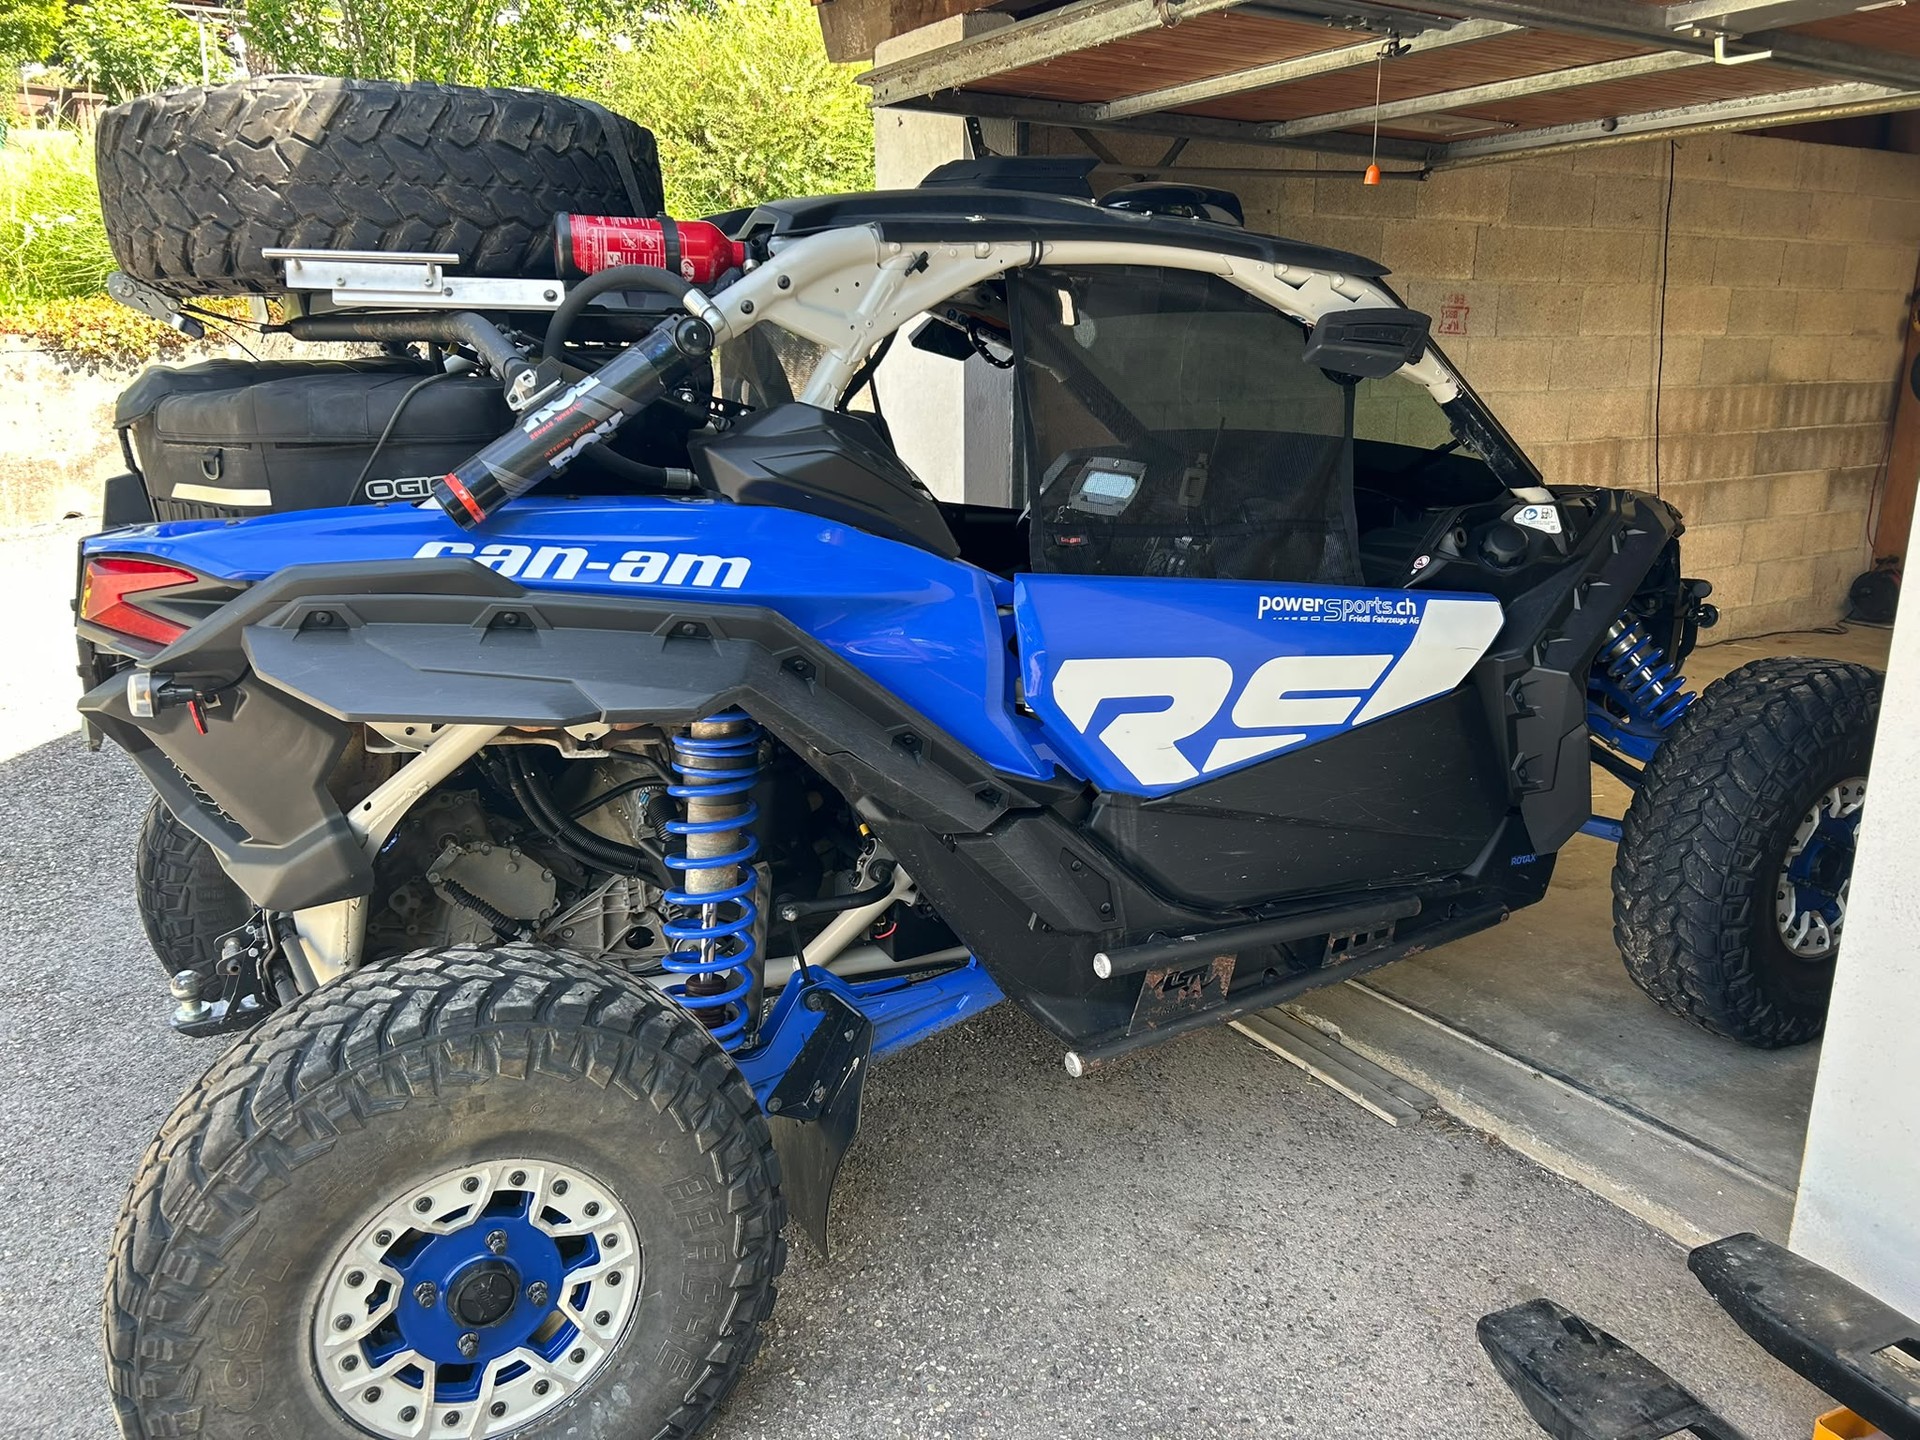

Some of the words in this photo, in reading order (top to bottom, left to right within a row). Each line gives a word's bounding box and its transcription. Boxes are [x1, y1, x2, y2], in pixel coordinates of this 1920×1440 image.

[365, 475, 448, 500] OGI
[1372, 615, 1407, 625] Fahrzeuge
[1409, 616, 1420, 625] AG
[1510, 853, 1537, 865] ROTAX
[653, 1172, 726, 1380] APACHE
